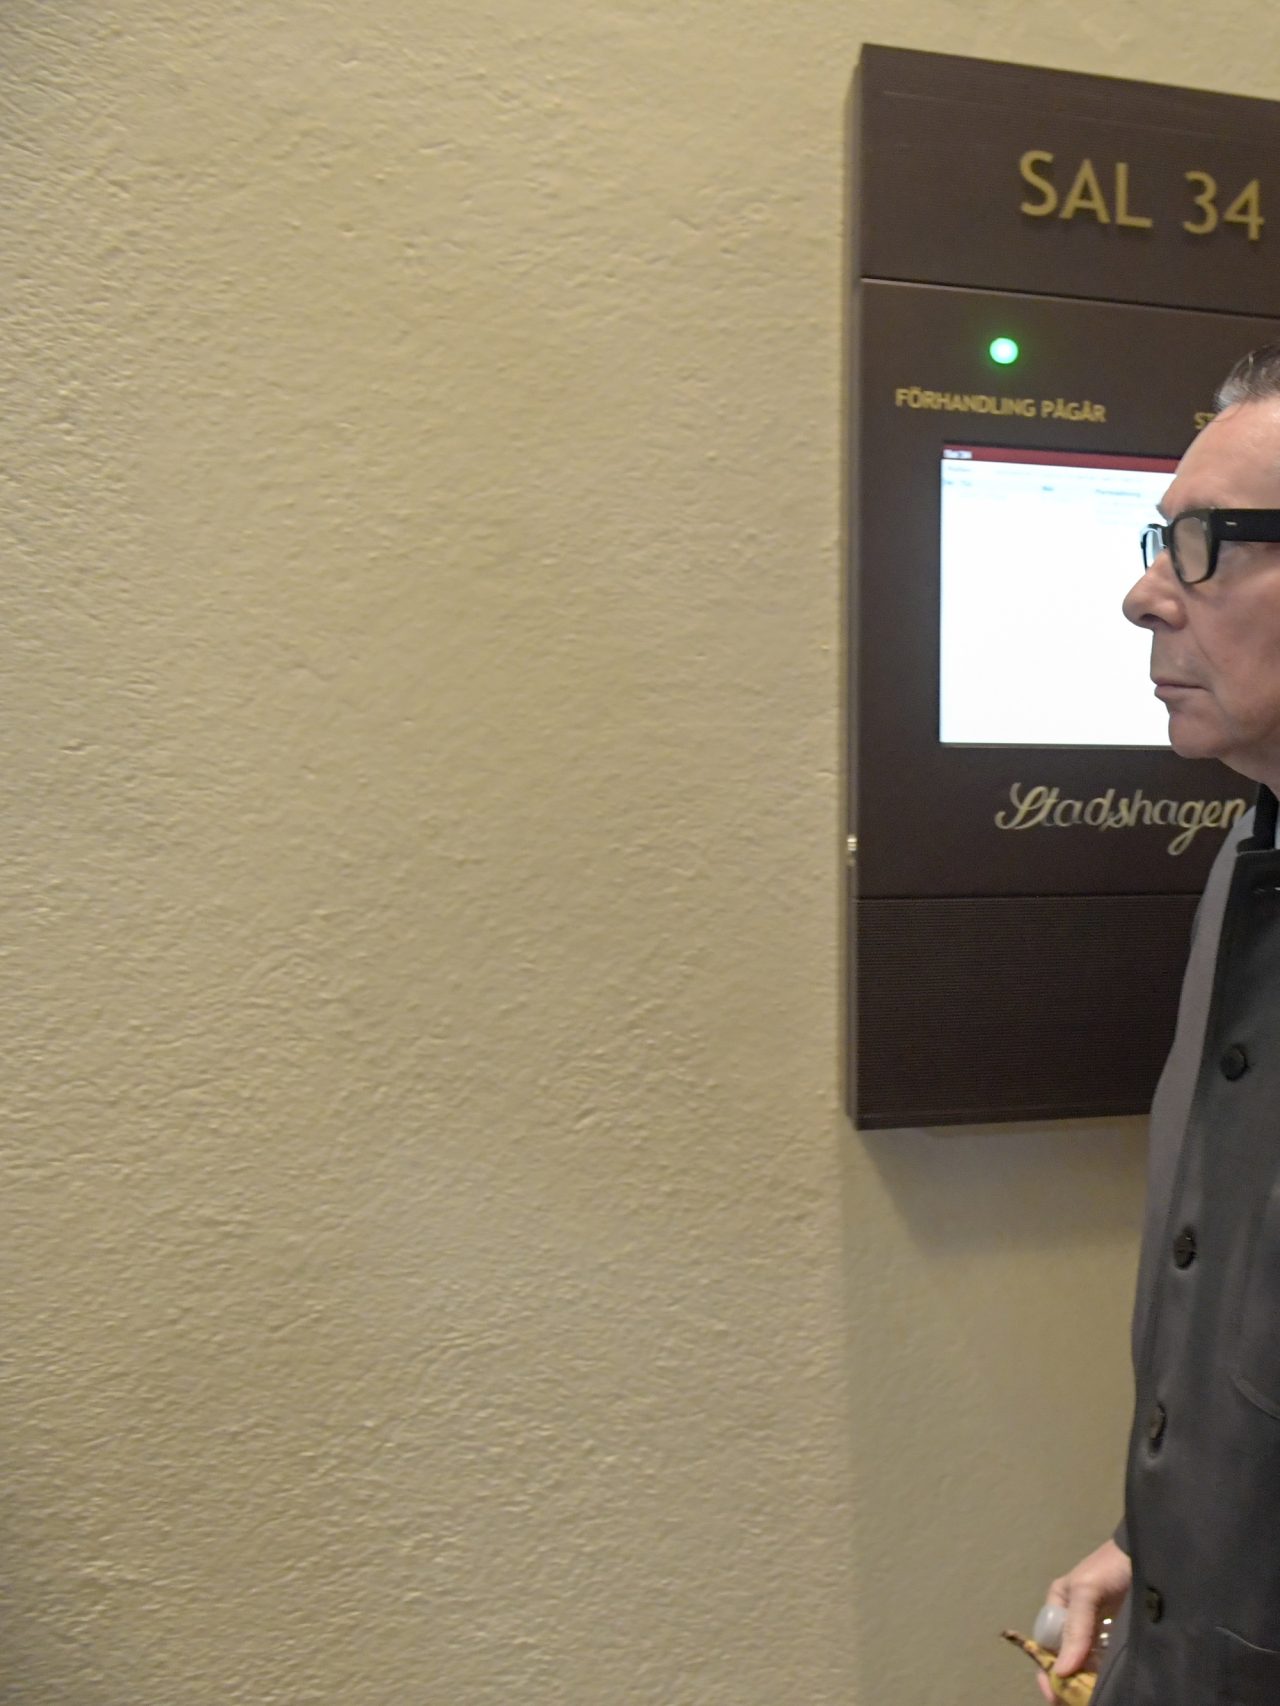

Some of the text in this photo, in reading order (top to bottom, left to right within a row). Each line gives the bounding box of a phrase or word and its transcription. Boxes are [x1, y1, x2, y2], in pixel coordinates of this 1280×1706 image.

[1019, 149, 1265, 241] SAL 34
[895, 386, 1107, 423] FÖRHANDLING PÅGÅR
[994, 782, 1247, 856] Stadshagen
